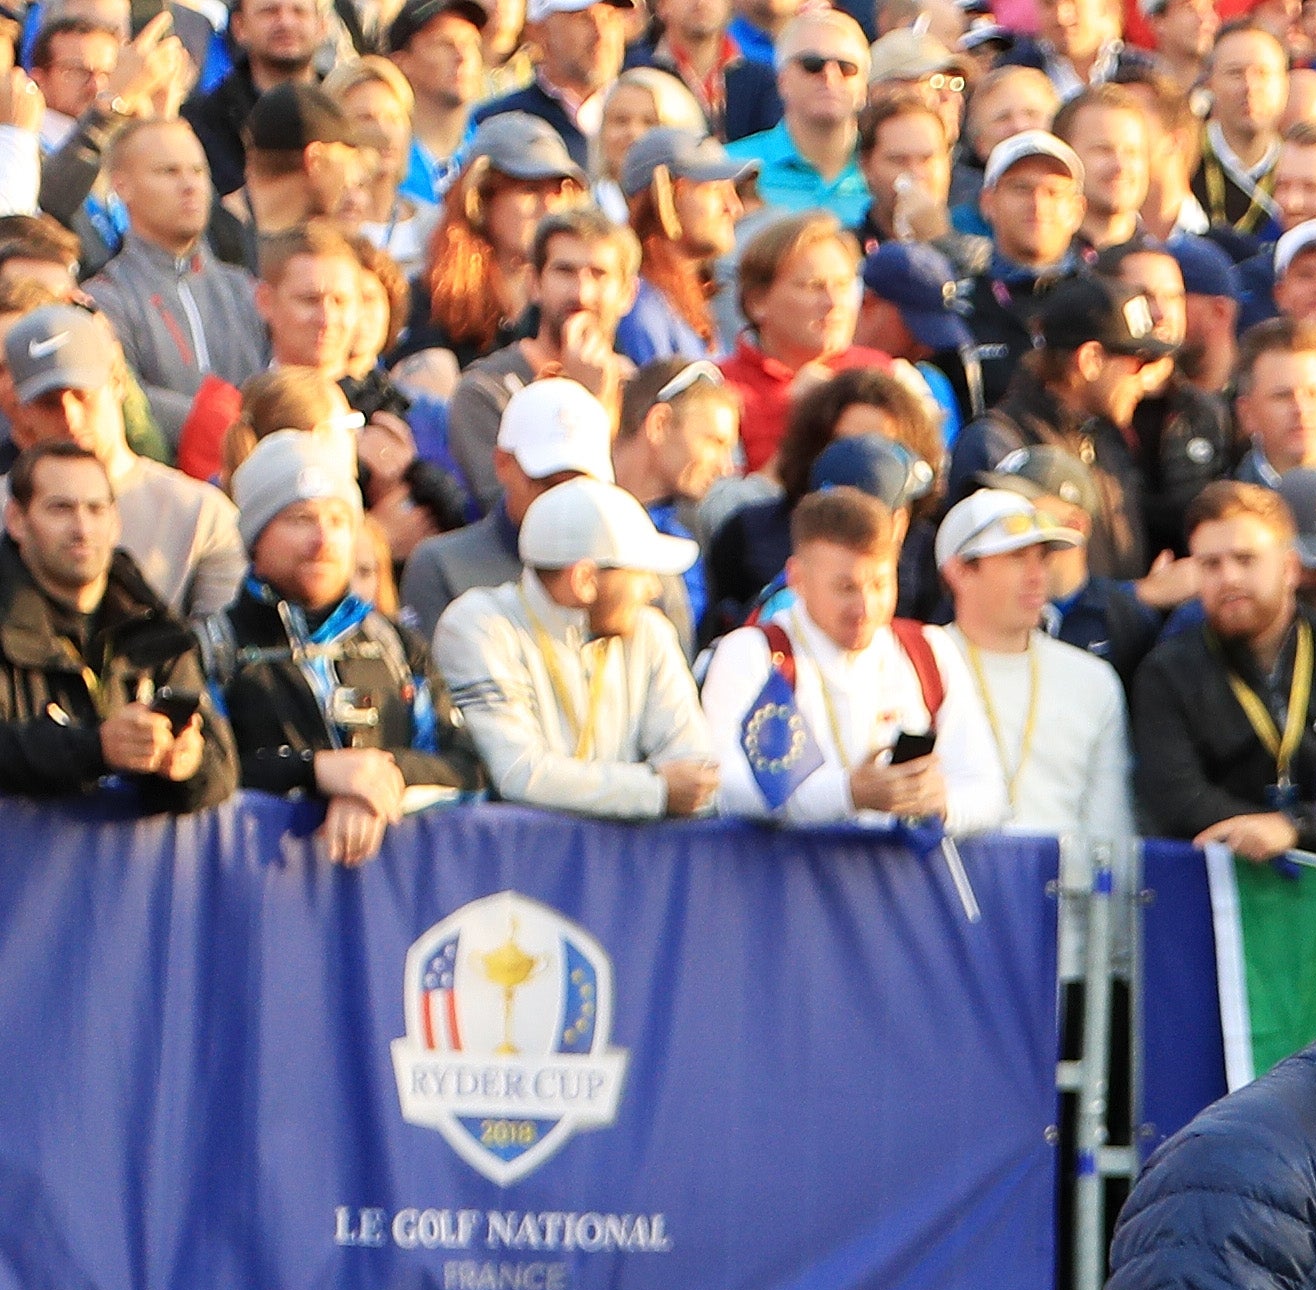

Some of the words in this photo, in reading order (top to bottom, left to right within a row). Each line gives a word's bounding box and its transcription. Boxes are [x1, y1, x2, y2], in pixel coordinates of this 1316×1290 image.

[410, 1062, 526, 1096] RYDER
[533, 1067, 605, 1100] CUP
[480, 1118, 537, 1144] 2018
[335, 1205, 386, 1248] LE
[391, 1208, 480, 1249] GOLF
[487, 1209, 673, 1252] NATIONAL
